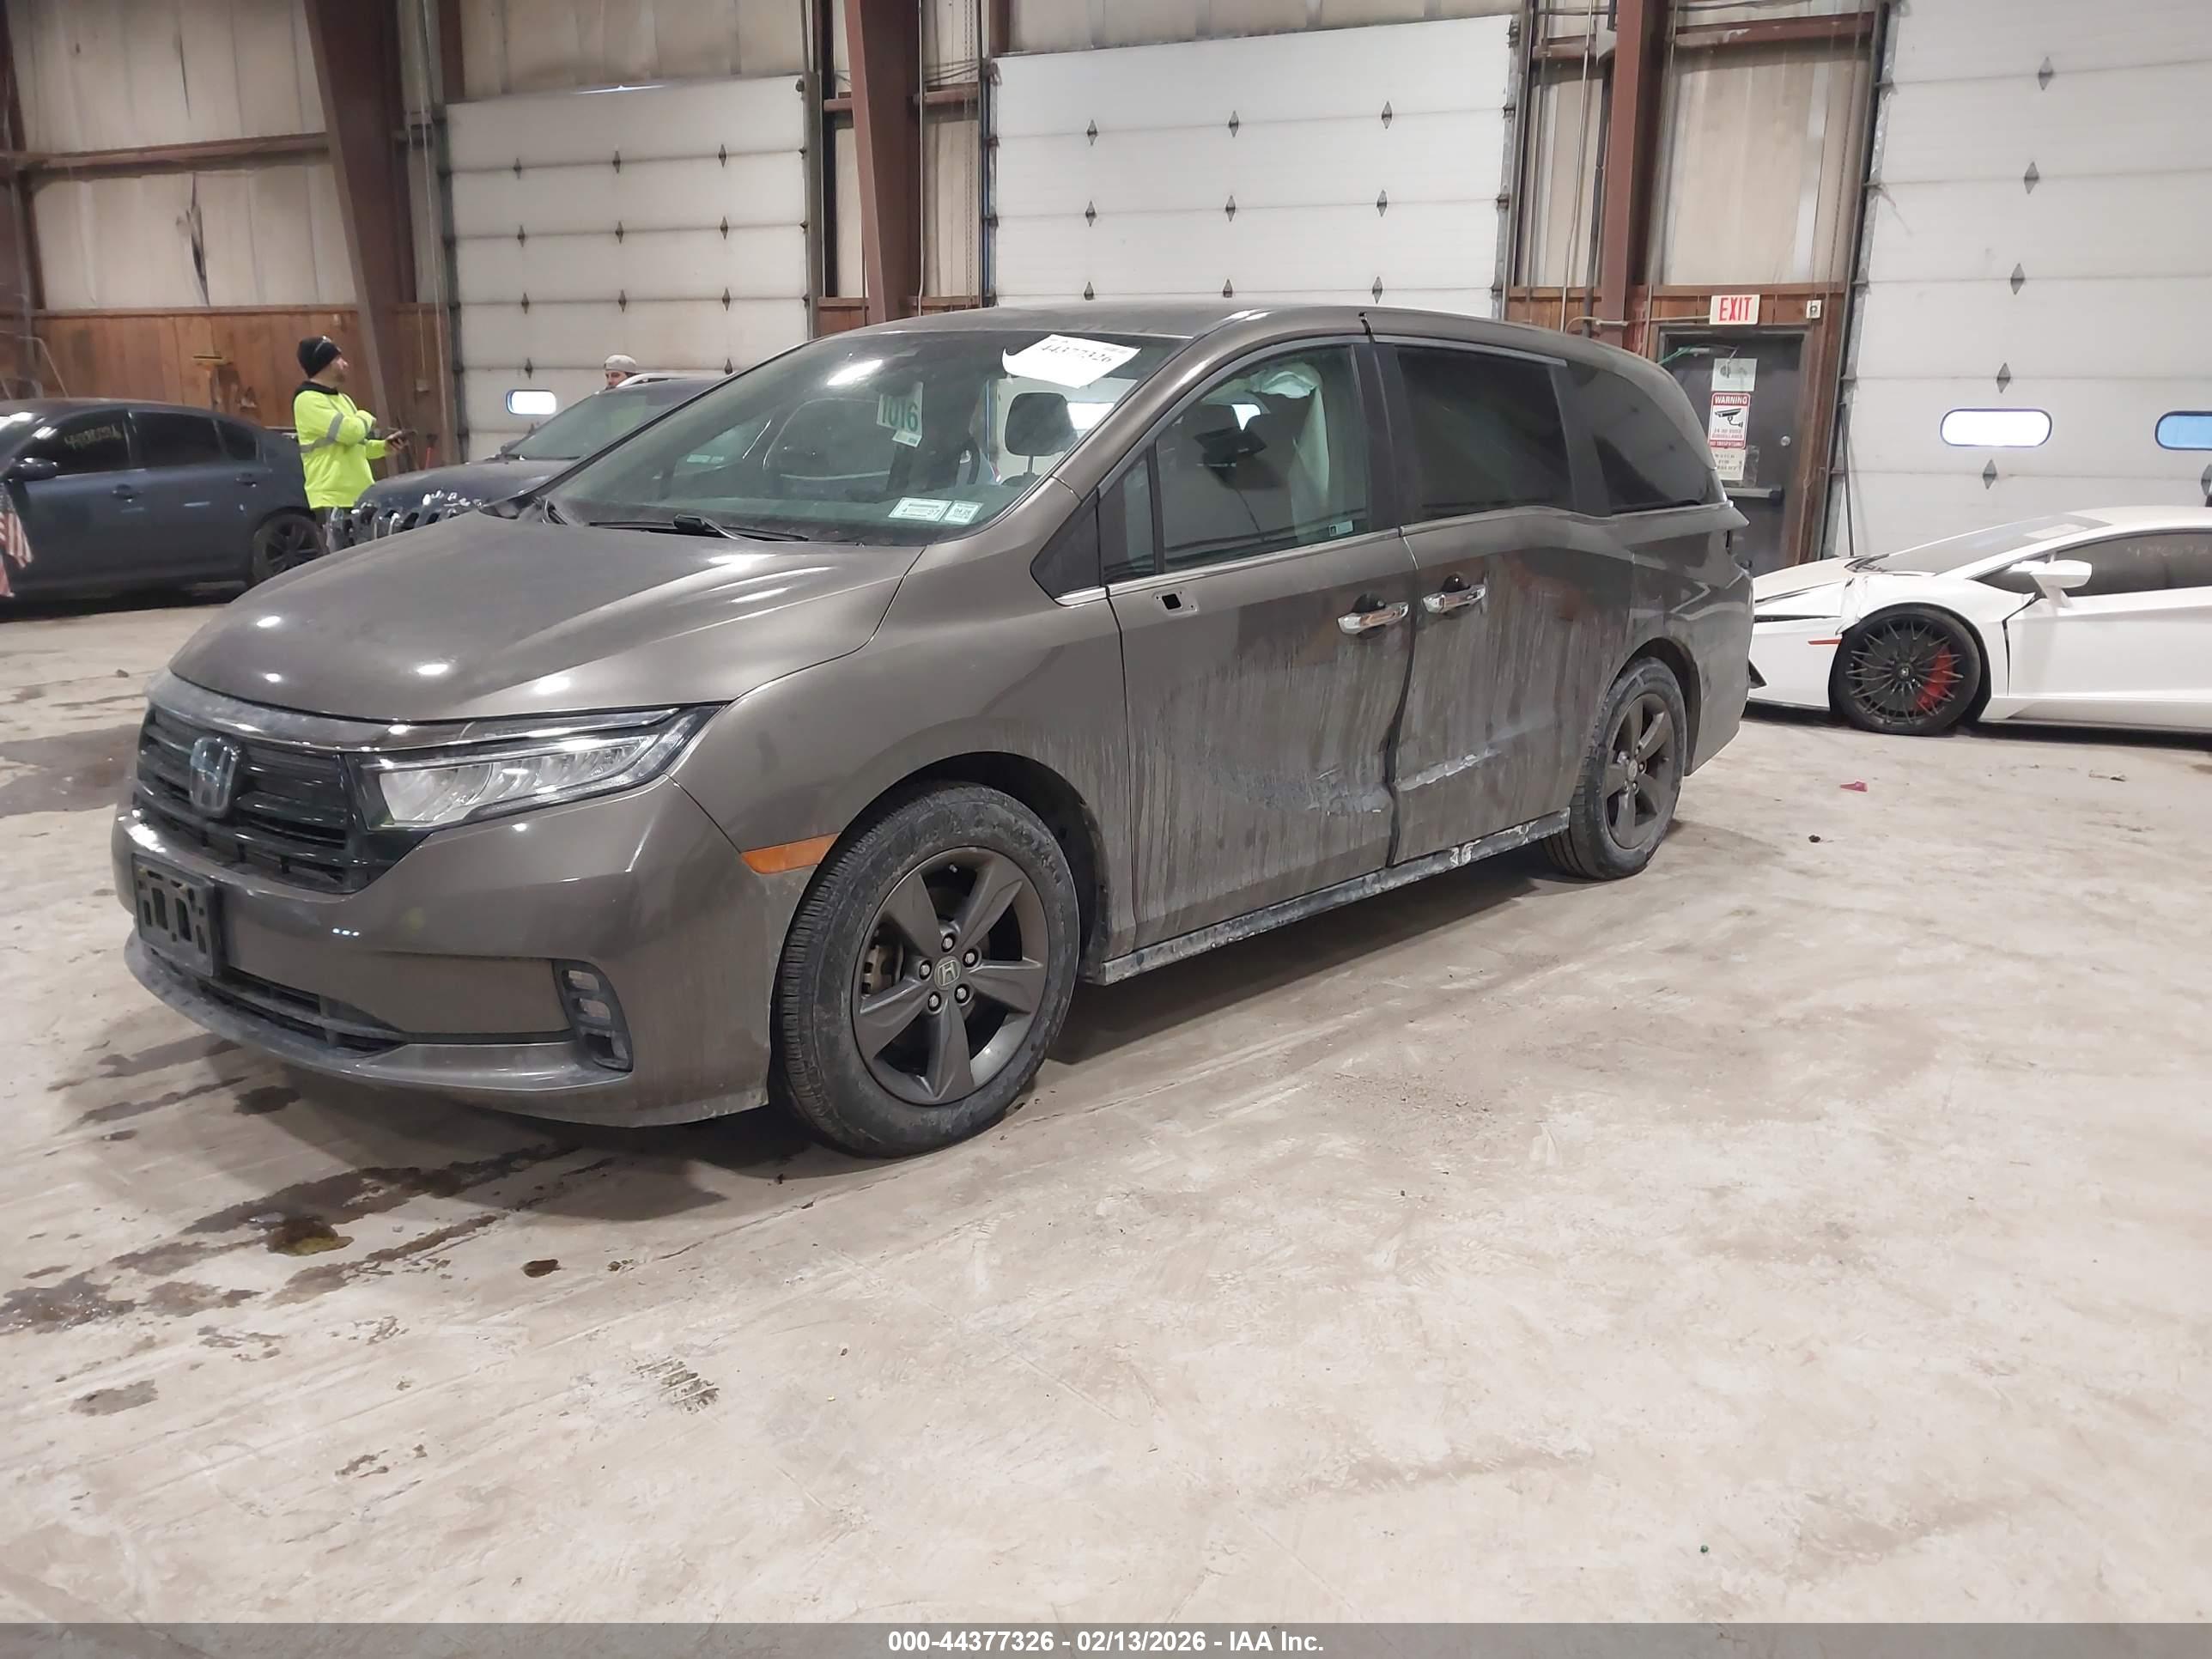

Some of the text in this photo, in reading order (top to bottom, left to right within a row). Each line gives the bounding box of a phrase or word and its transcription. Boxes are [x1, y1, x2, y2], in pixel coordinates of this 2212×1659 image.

[1719, 297, 1753, 321] EXIT
[1714, 395, 1748, 404] WARNING
[882, 397, 919, 432] 1016
